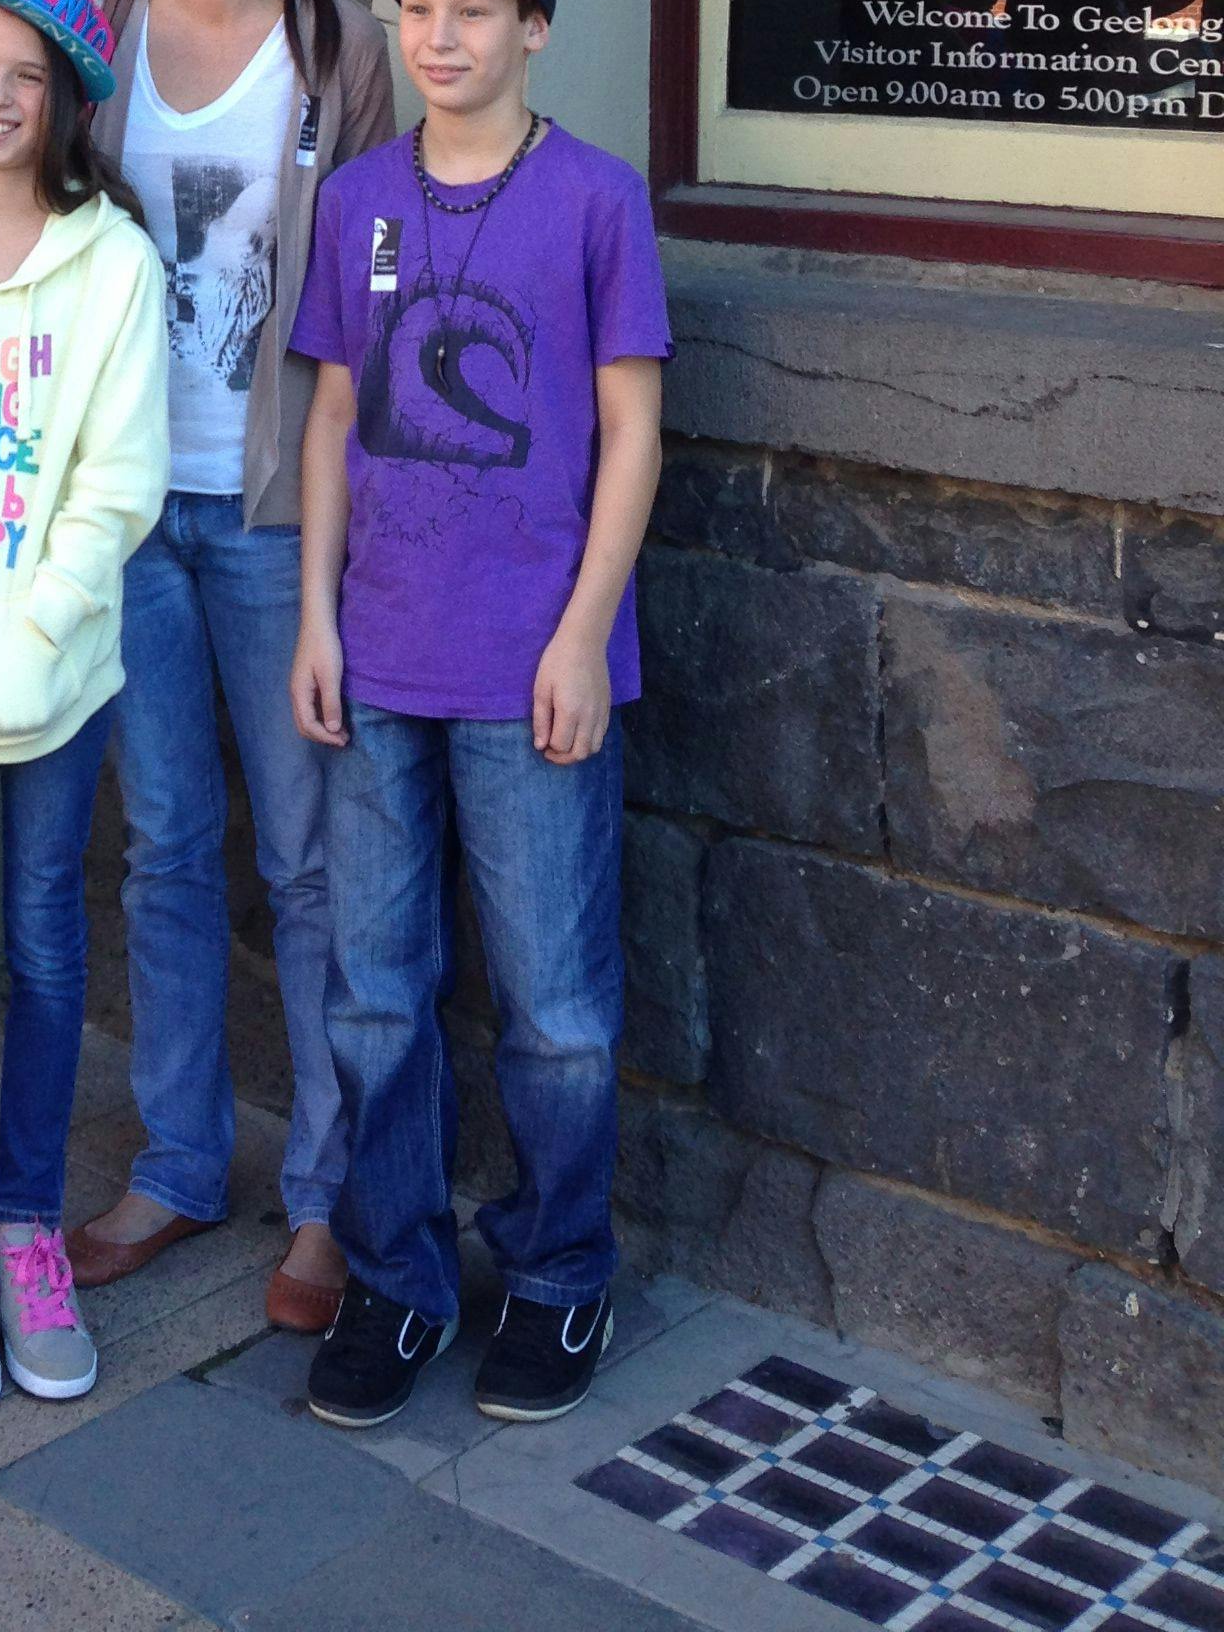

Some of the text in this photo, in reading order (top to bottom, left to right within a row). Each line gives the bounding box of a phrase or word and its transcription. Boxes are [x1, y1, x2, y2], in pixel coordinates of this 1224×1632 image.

[863, 0, 1224, 43] Welcome To Geelong
[814, 40, 922, 66] Visitor
[930, 41, 1139, 74] Information
[793, 75, 879, 107] Open
[886, 80, 1002, 108] 9.00am
[1013, 87, 1046, 110] to
[1058, 86, 1188, 119] 5.00pm
